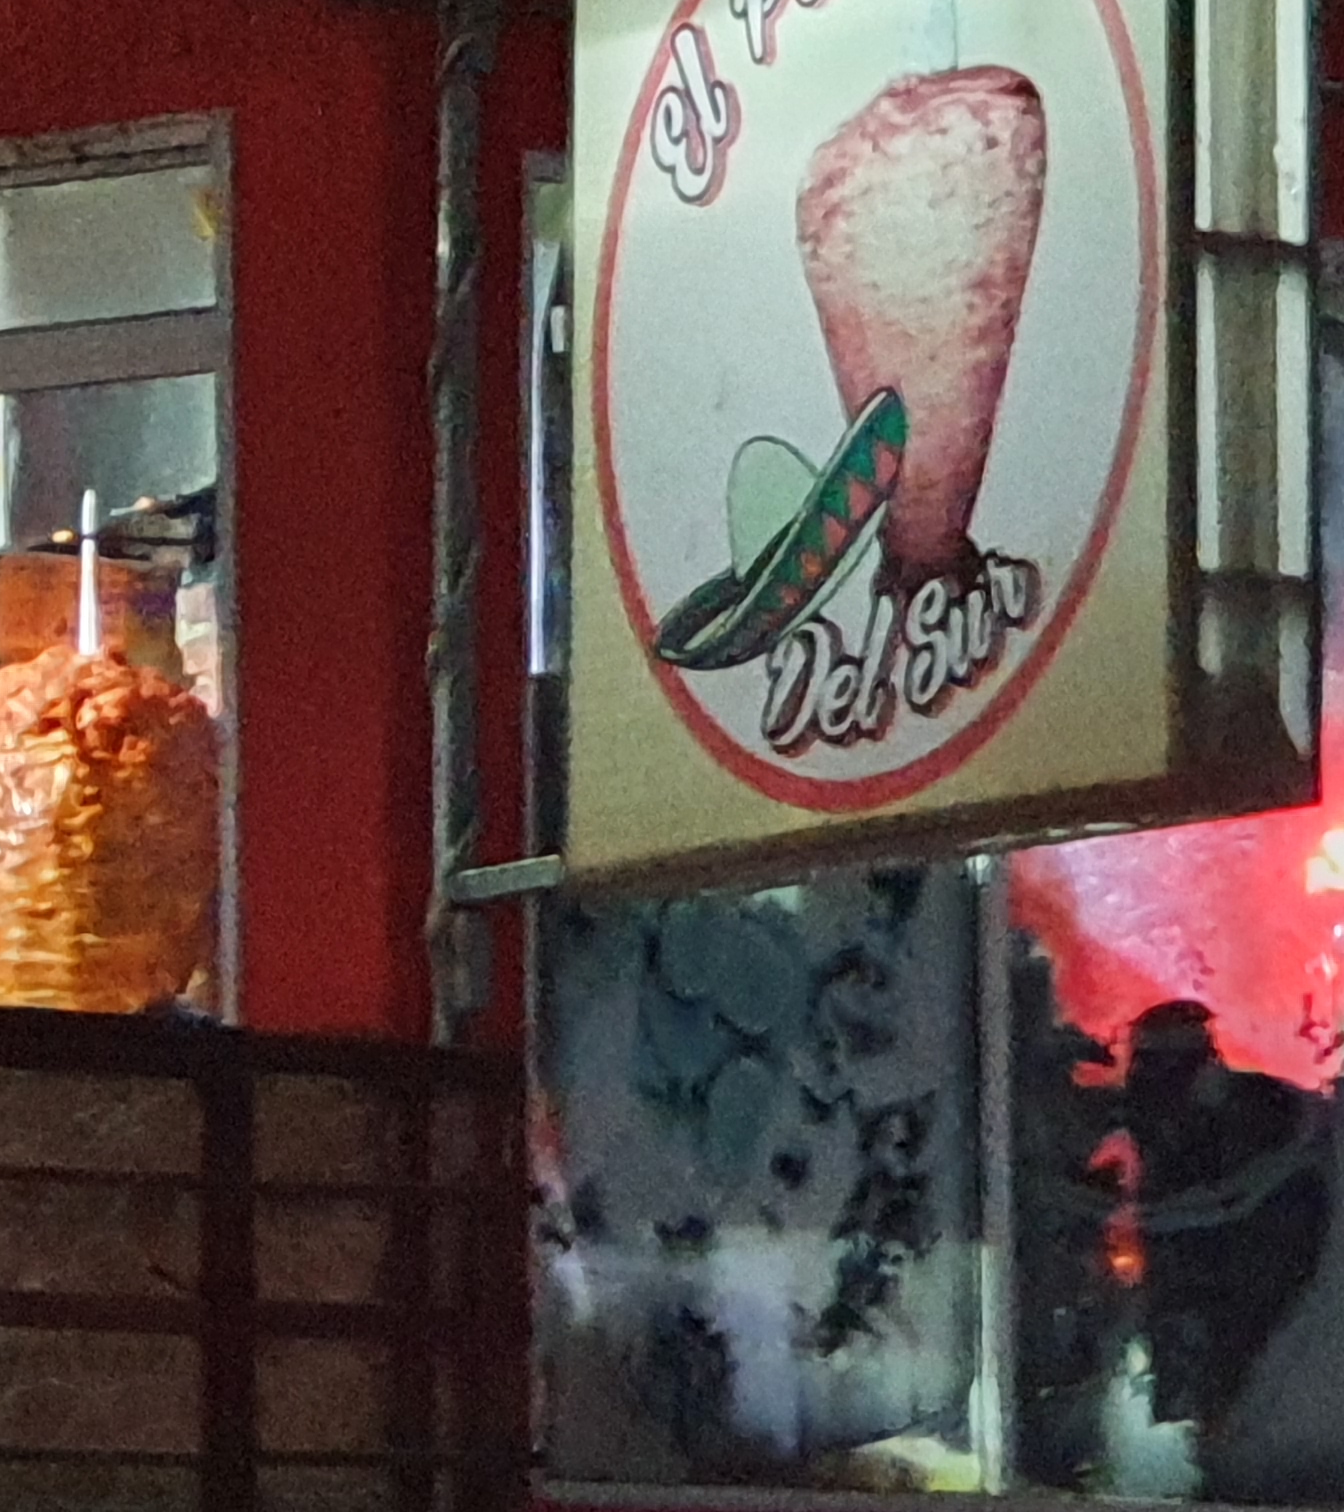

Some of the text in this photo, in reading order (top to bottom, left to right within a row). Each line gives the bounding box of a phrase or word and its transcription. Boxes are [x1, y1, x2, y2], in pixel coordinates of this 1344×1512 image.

[651, 23, 742, 206] El
[761, 550, 1043, 757] Del Sur
